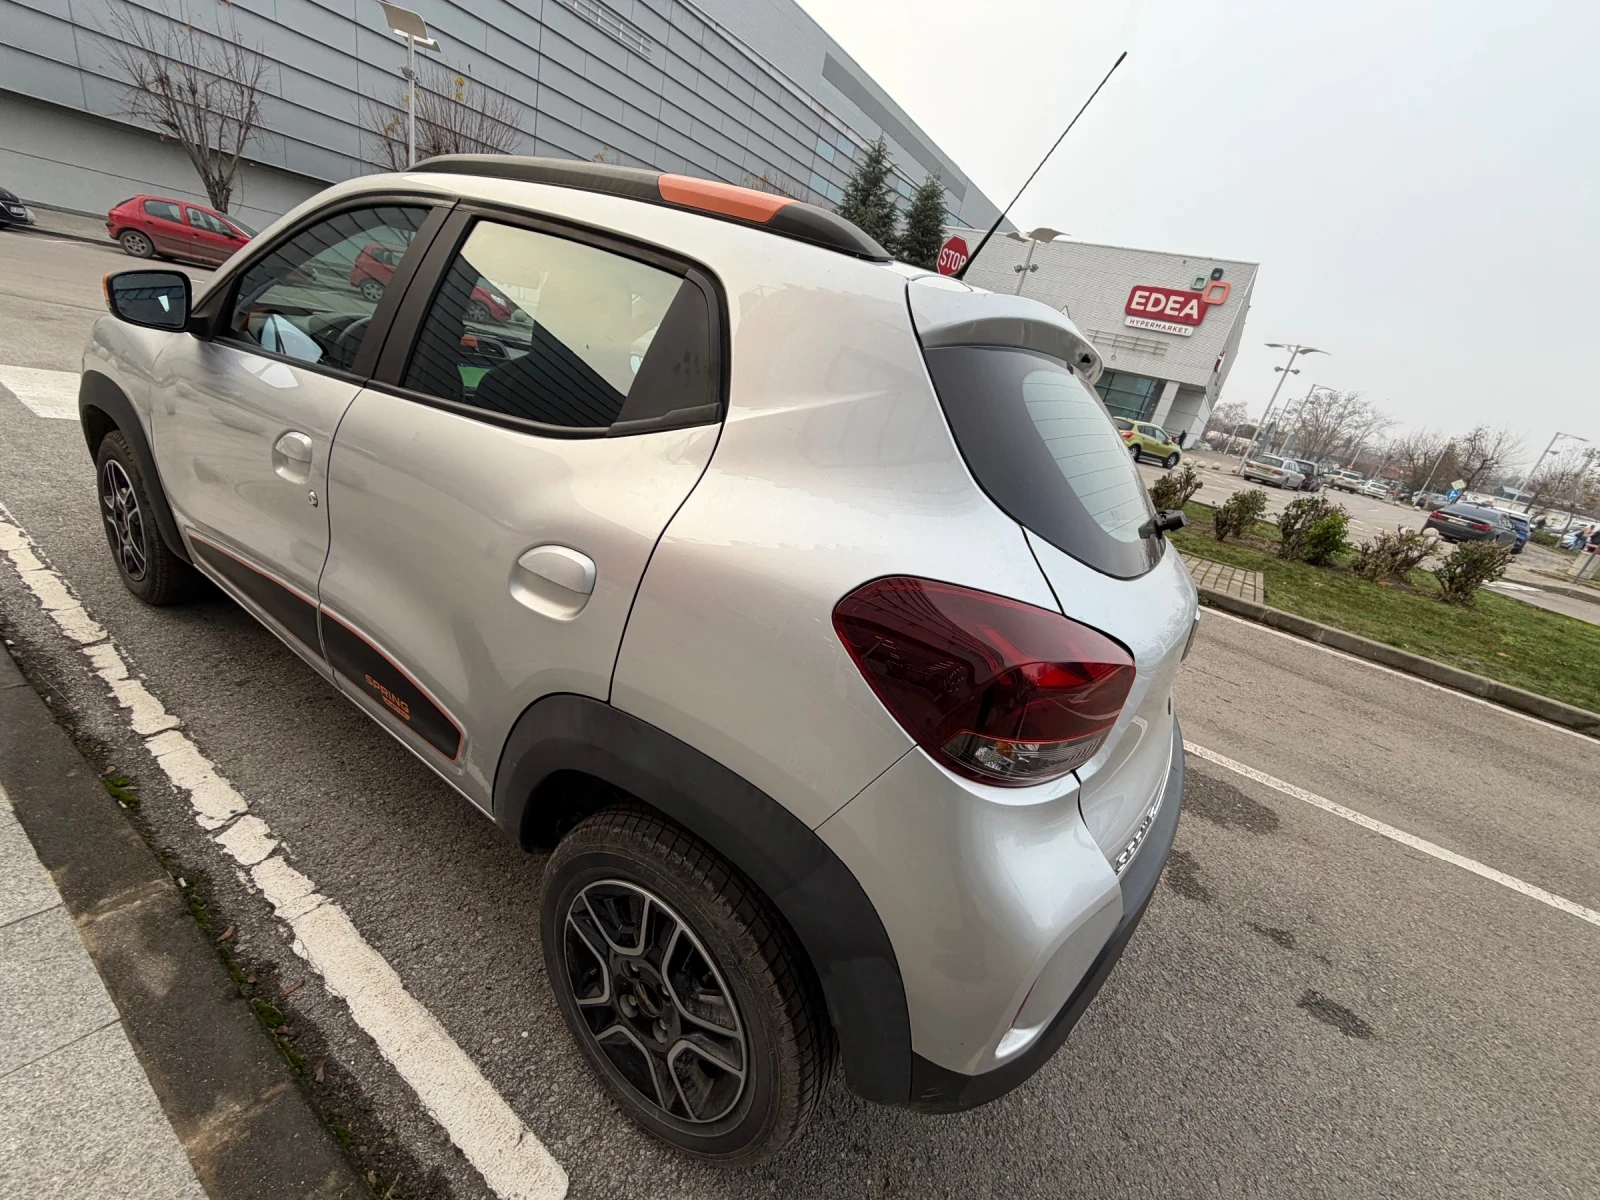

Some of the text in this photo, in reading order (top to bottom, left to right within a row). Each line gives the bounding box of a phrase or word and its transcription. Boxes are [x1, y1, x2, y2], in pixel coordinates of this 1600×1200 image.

[940, 248, 966, 270] STOP
[1130, 290, 1199, 319] EDEA
[1129, 319, 1188, 334] HYPERMARKET
[365, 674, 409, 713] SPRING
